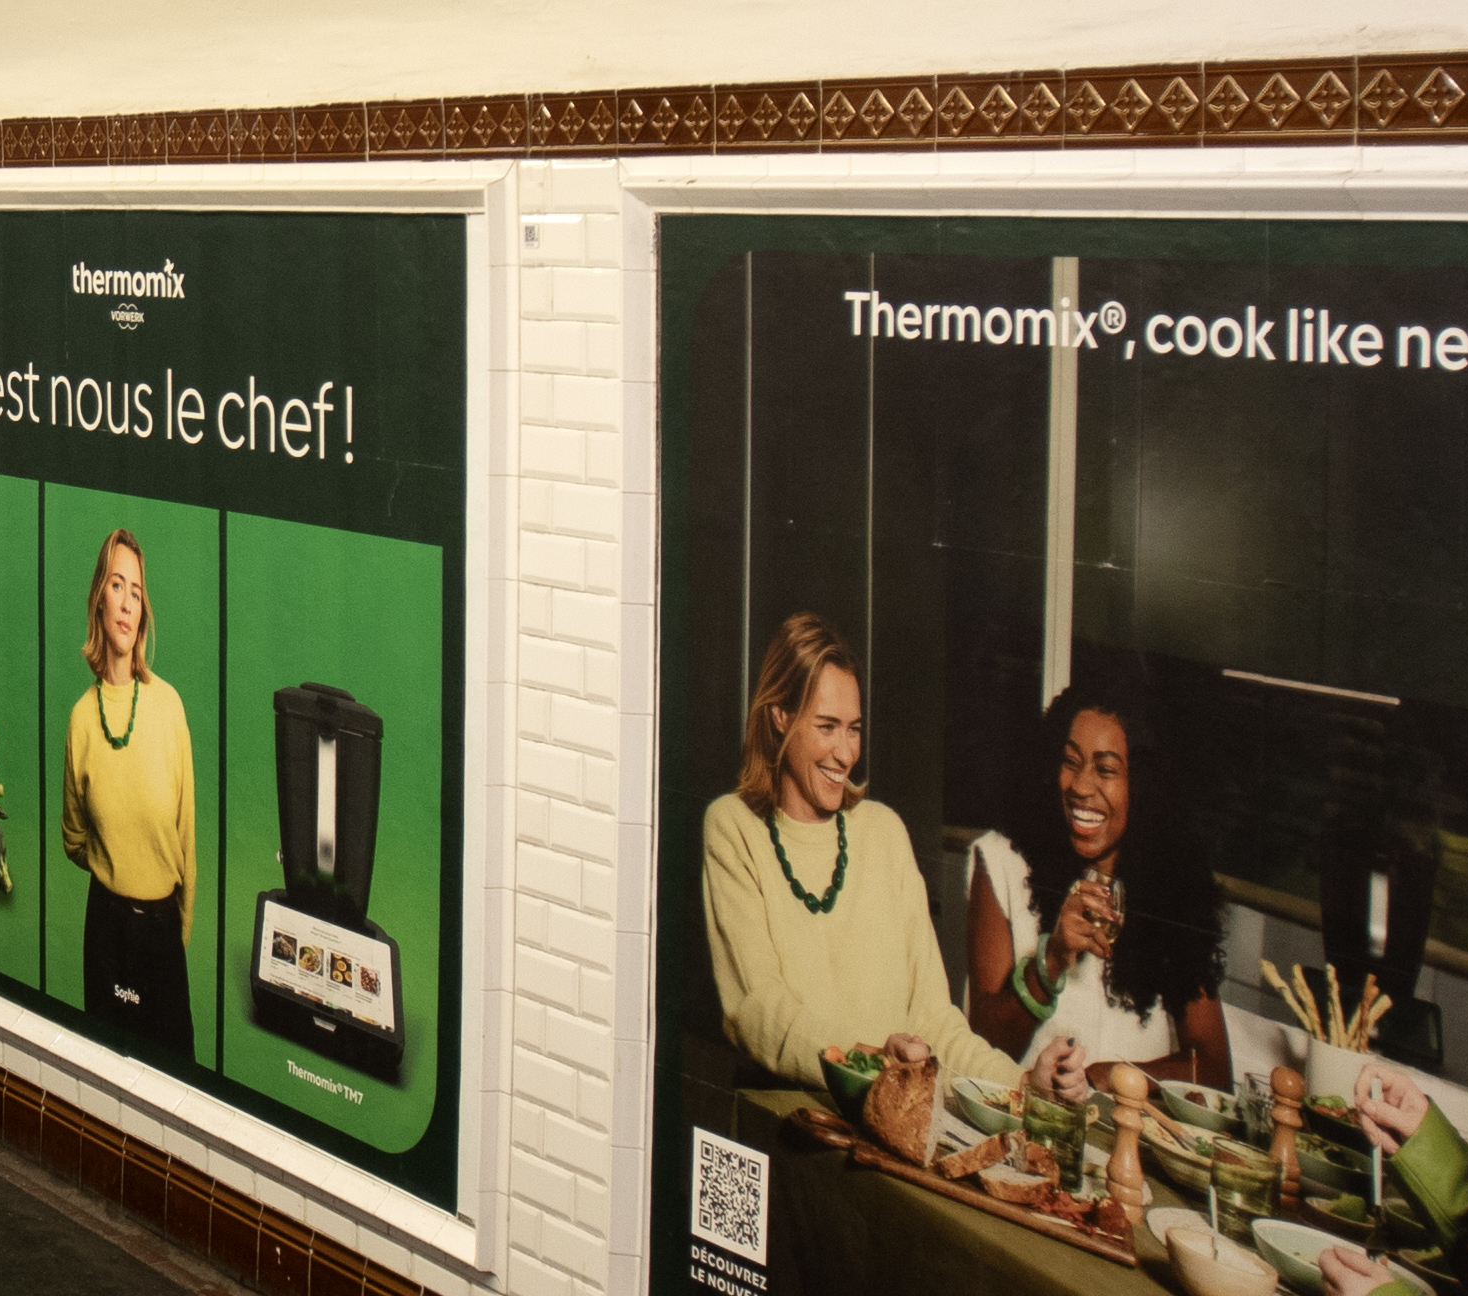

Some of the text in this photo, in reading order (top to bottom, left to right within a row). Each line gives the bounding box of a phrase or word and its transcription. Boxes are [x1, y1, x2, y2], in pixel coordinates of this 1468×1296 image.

[72, 258, 185, 298] thermomix
[111, 311, 144, 323] VORWERK
[1146, 306, 1275, 360] cook
[1285, 308, 1384, 366] like
[51, 375, 153, 438] nous
[166, 368, 205, 444] le
[115, 984, 139, 1004] Sophie
[287, 1060, 363, 1105] Thermomix® TM7
[691, 1245, 768, 1290] DÉCOUVREZ
[691, 1265, 705, 1283] LE
